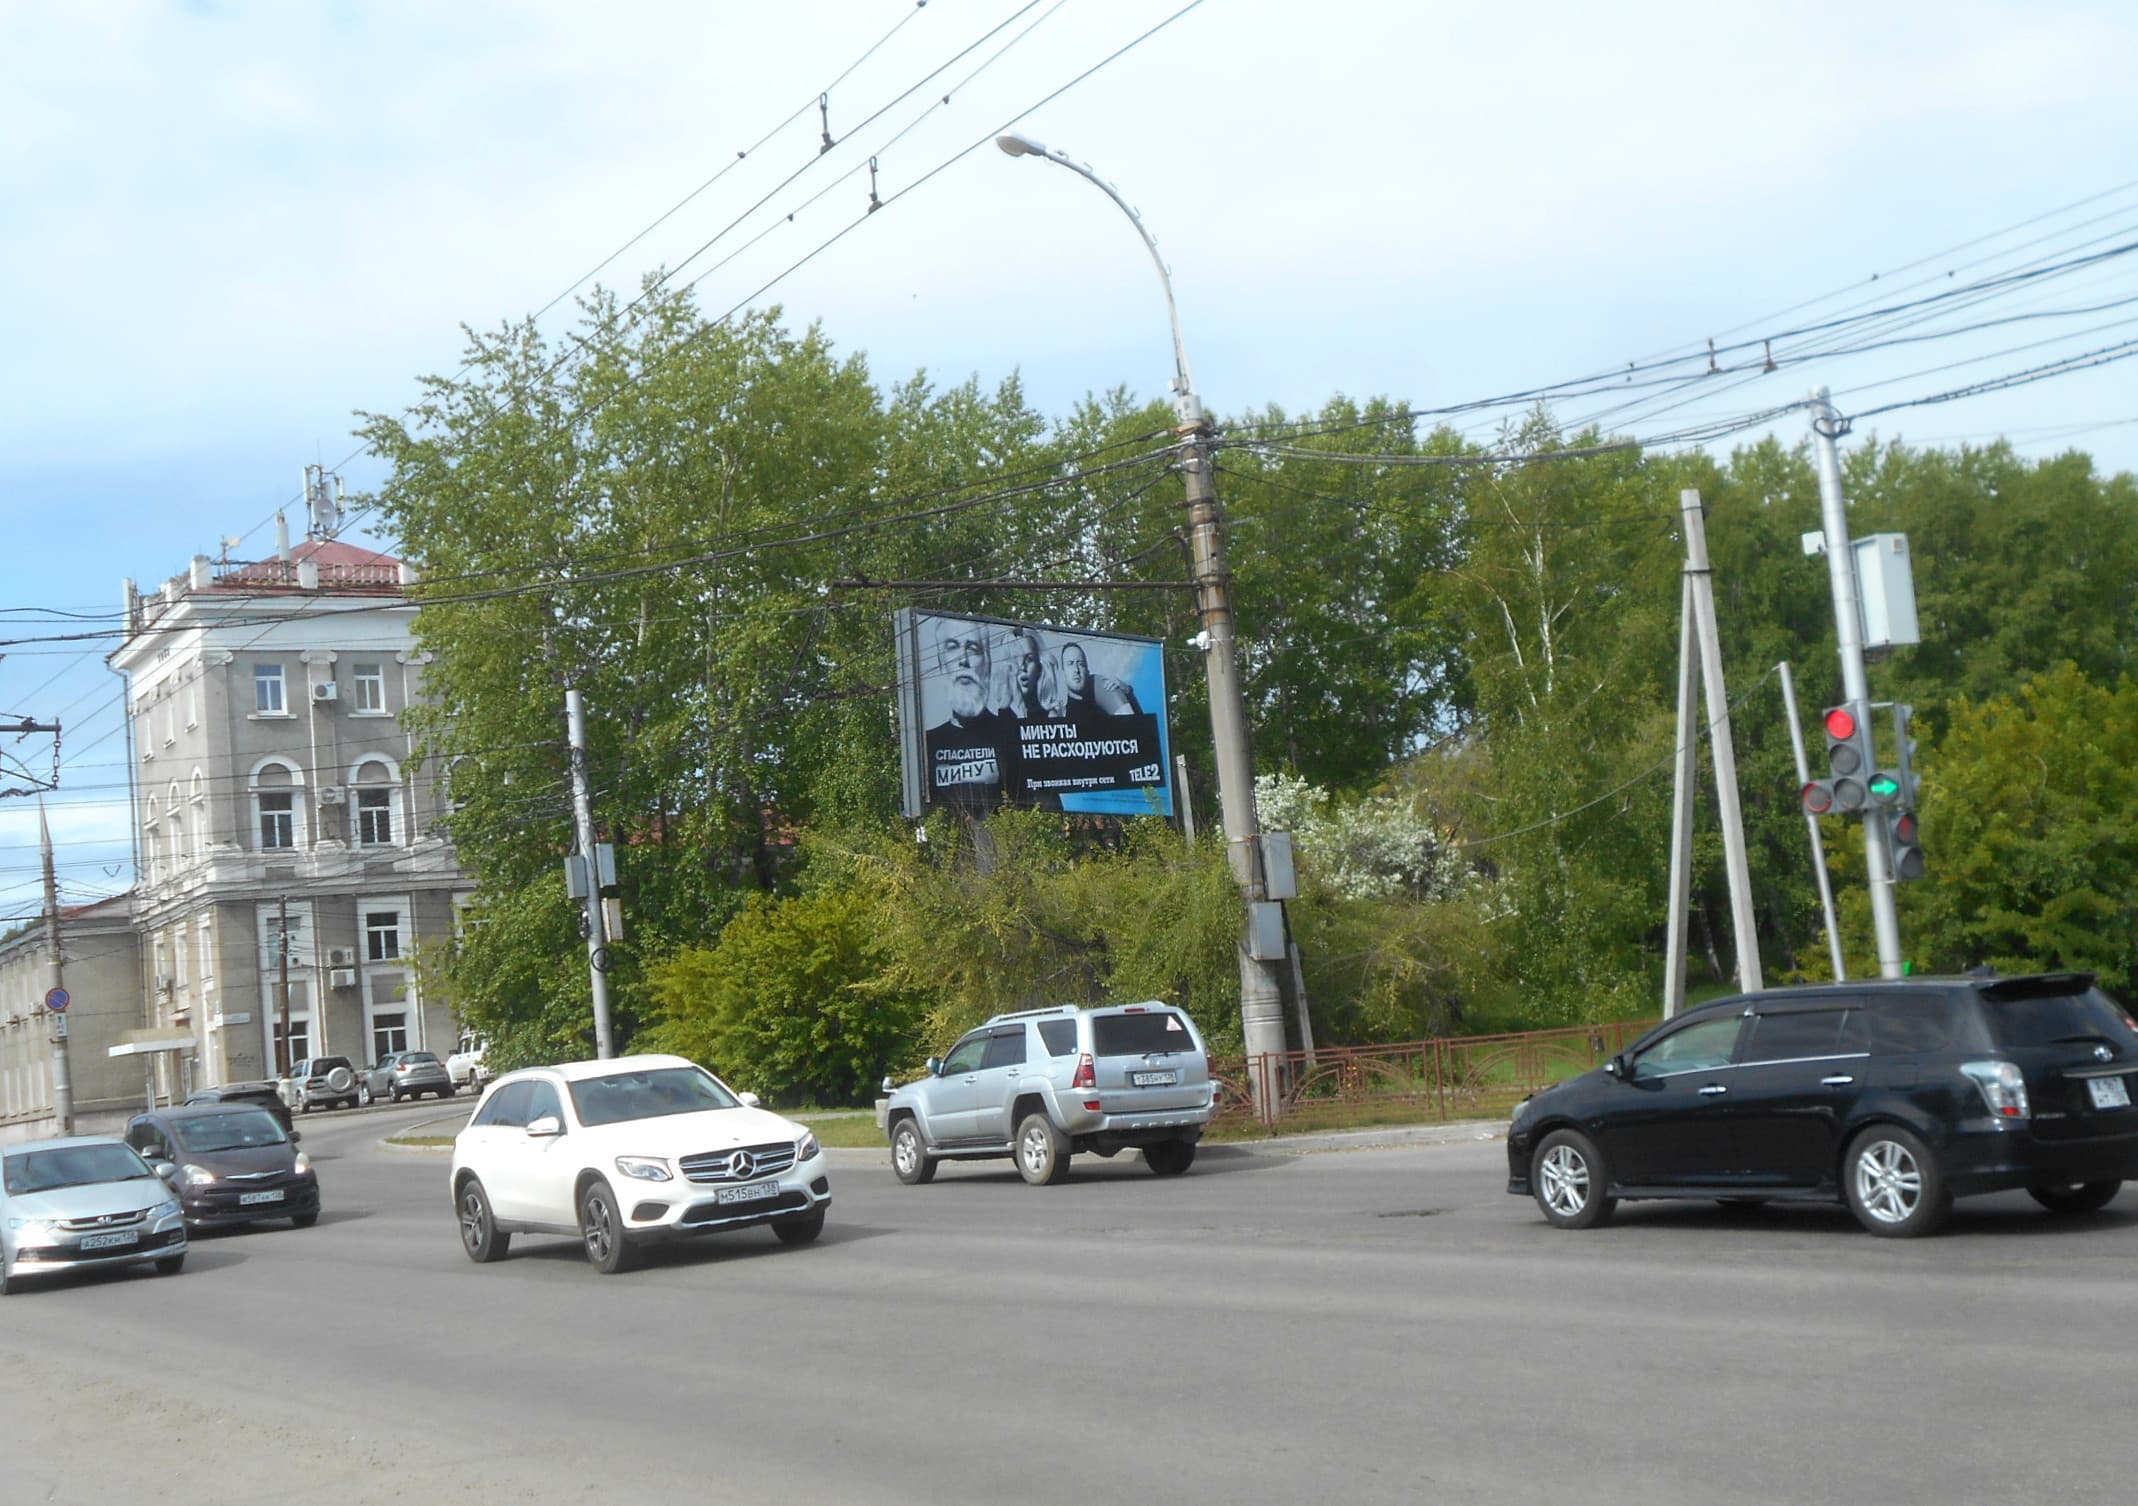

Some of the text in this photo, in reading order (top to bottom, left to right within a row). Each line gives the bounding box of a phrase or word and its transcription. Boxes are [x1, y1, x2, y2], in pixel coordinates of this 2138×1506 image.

[1020, 723, 1077, 741] МИНУТЫ
[935, 747, 996, 760] СПАСАТЕЛИ
[1023, 739, 1138, 759] НЕ РАСХОДУЮТСЯ
[936, 761, 995, 784] МИНУТ
[1129, 763, 1160, 783] TELE2
[1026, 779, 1043, 791] При
[1072, 777, 1098, 788] внутри
[1099, 776, 1115, 784] сети
